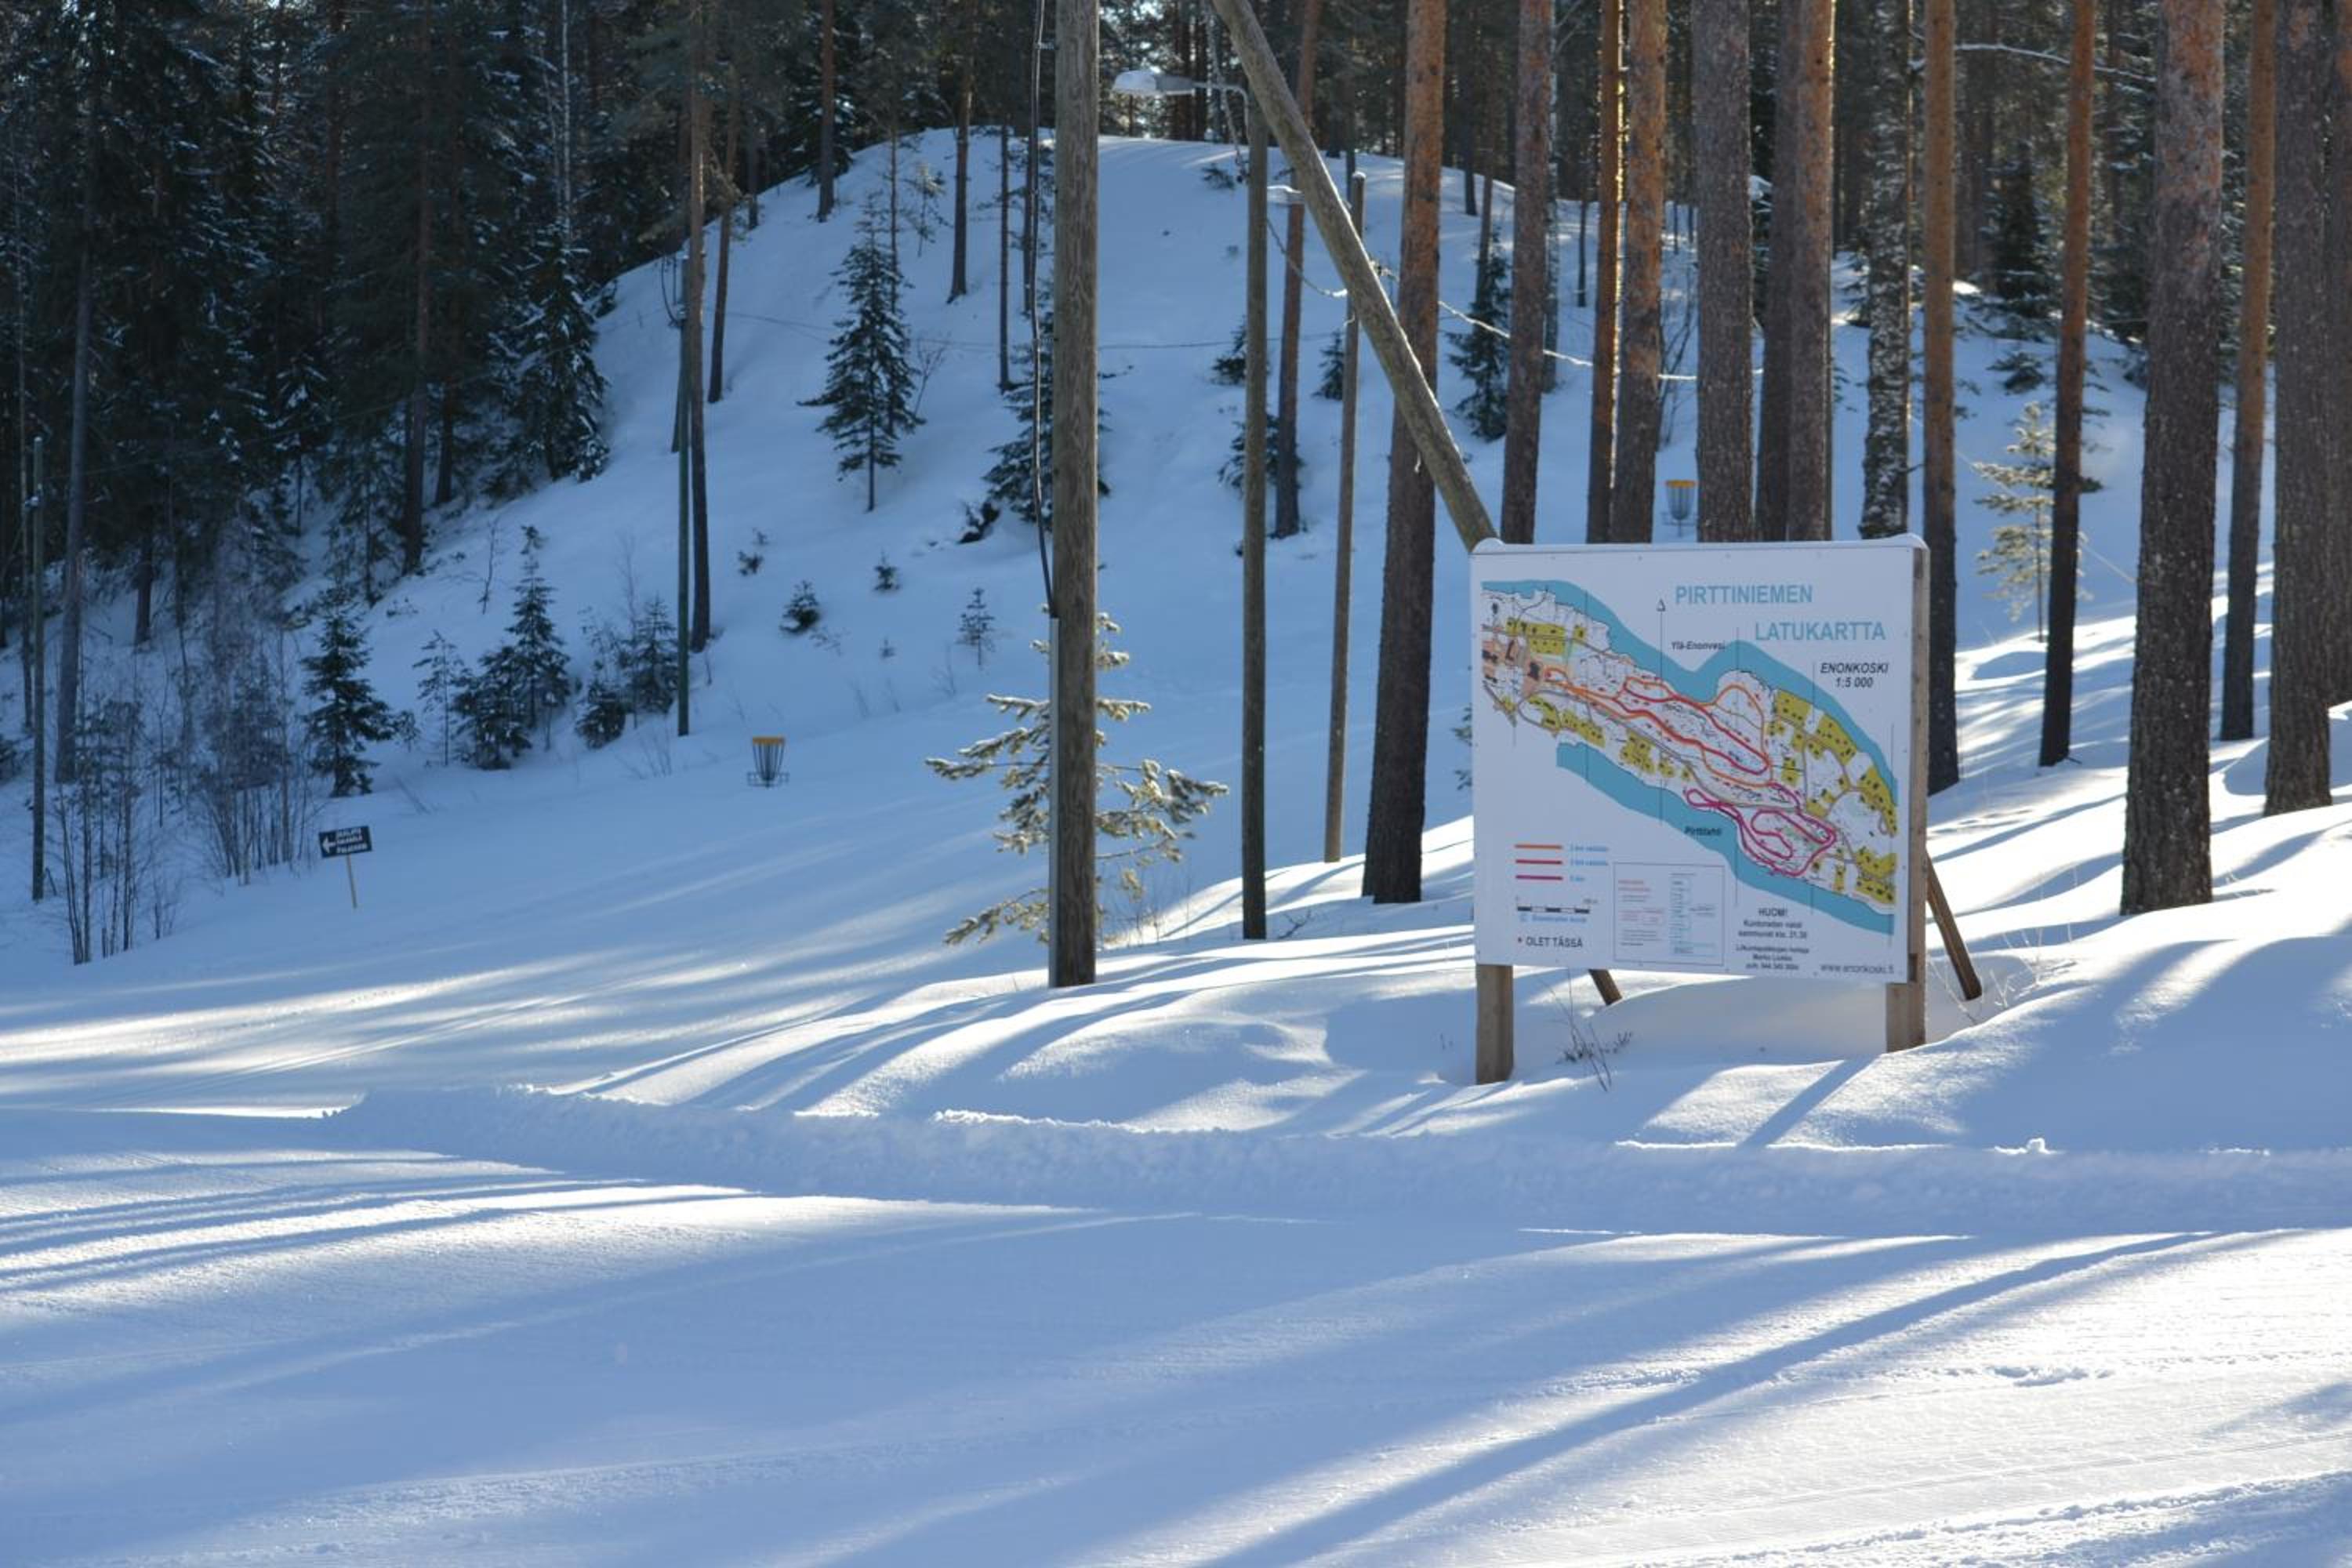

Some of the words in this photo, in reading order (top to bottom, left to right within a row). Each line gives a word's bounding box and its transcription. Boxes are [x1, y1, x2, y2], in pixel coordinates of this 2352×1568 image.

[1675, 585, 1813, 604] PIRTTINIEMEN
[1755, 622, 1886, 641] LATUKARTTA
[1820, 662, 1889, 674] ENONKOSKI
[1835, 676, 1852, 688] 1:5
[1853, 677, 1874, 688] 000
[1526, 936, 1550, 946] OLET
[1552, 935, 1583, 947] TÄSSÄ
